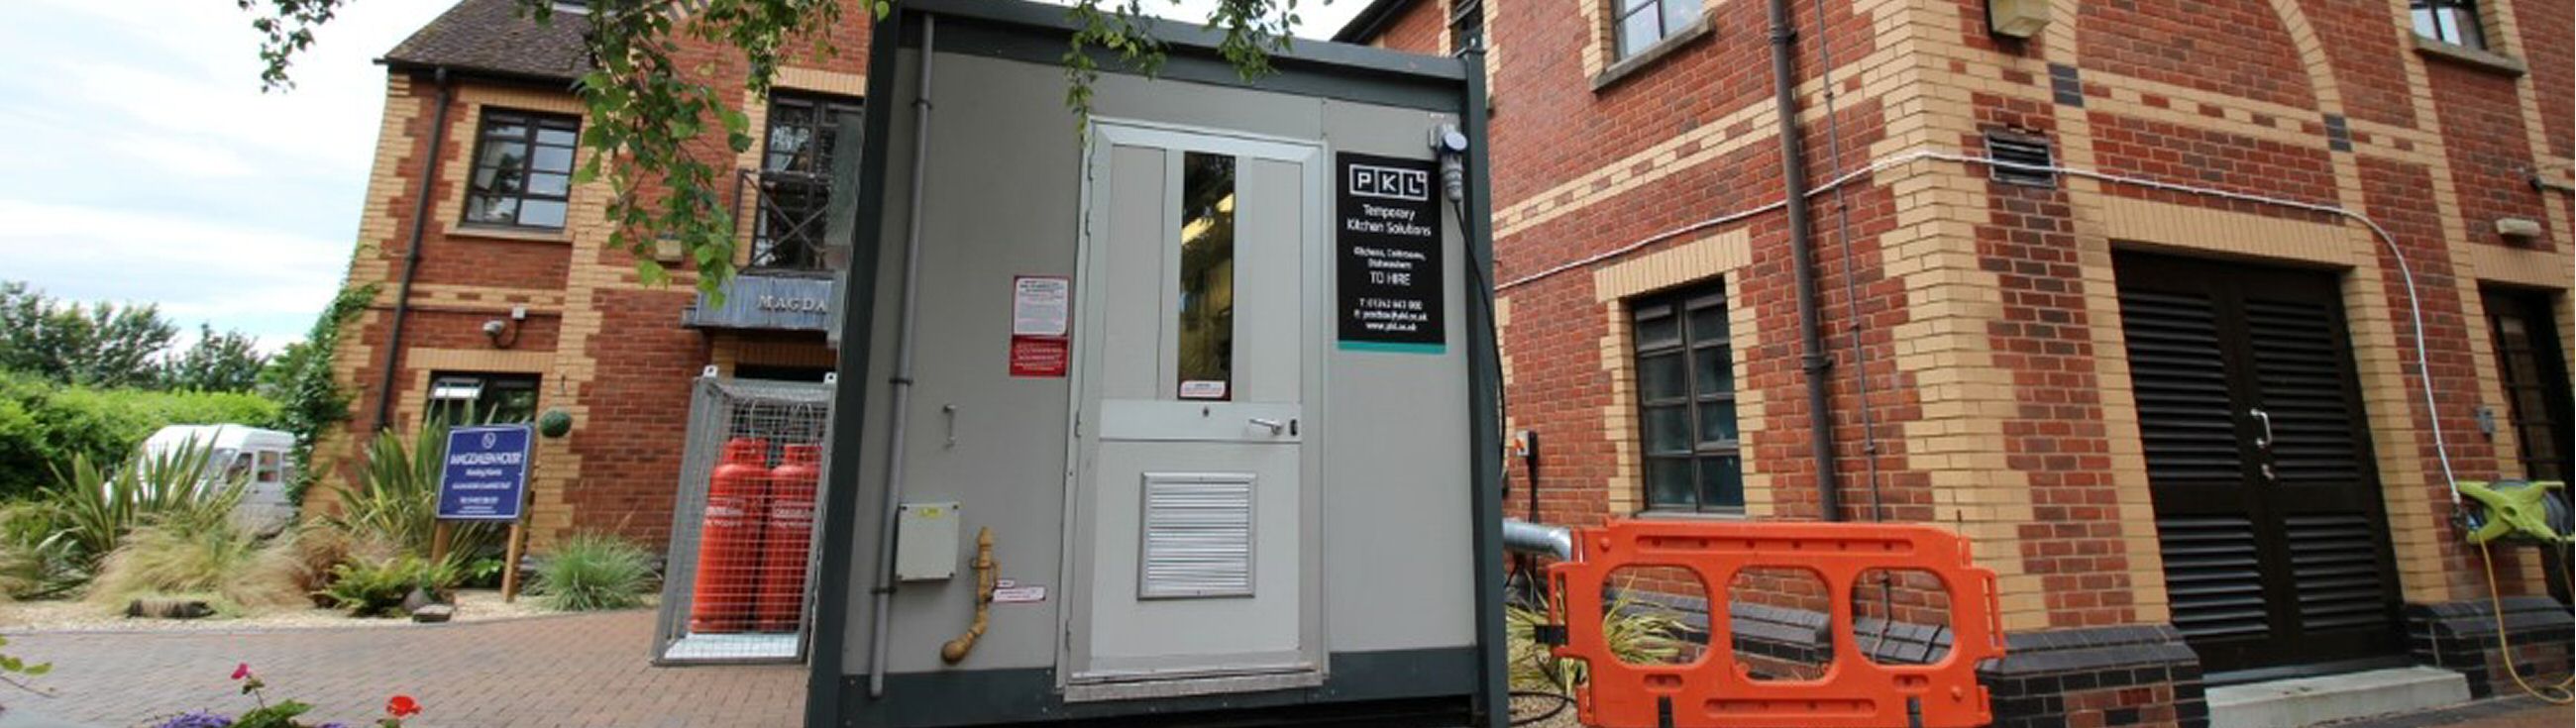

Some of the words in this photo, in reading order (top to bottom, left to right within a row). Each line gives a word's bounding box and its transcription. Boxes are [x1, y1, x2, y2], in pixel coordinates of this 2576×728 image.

[1362, 203, 1416, 221] Temporary
[1346, 217, 1384, 232] Kitchen
[1386, 221, 1432, 237] Solutions
[1369, 270, 1384, 284] TO
[1386, 272, 1411, 286] HIRE
